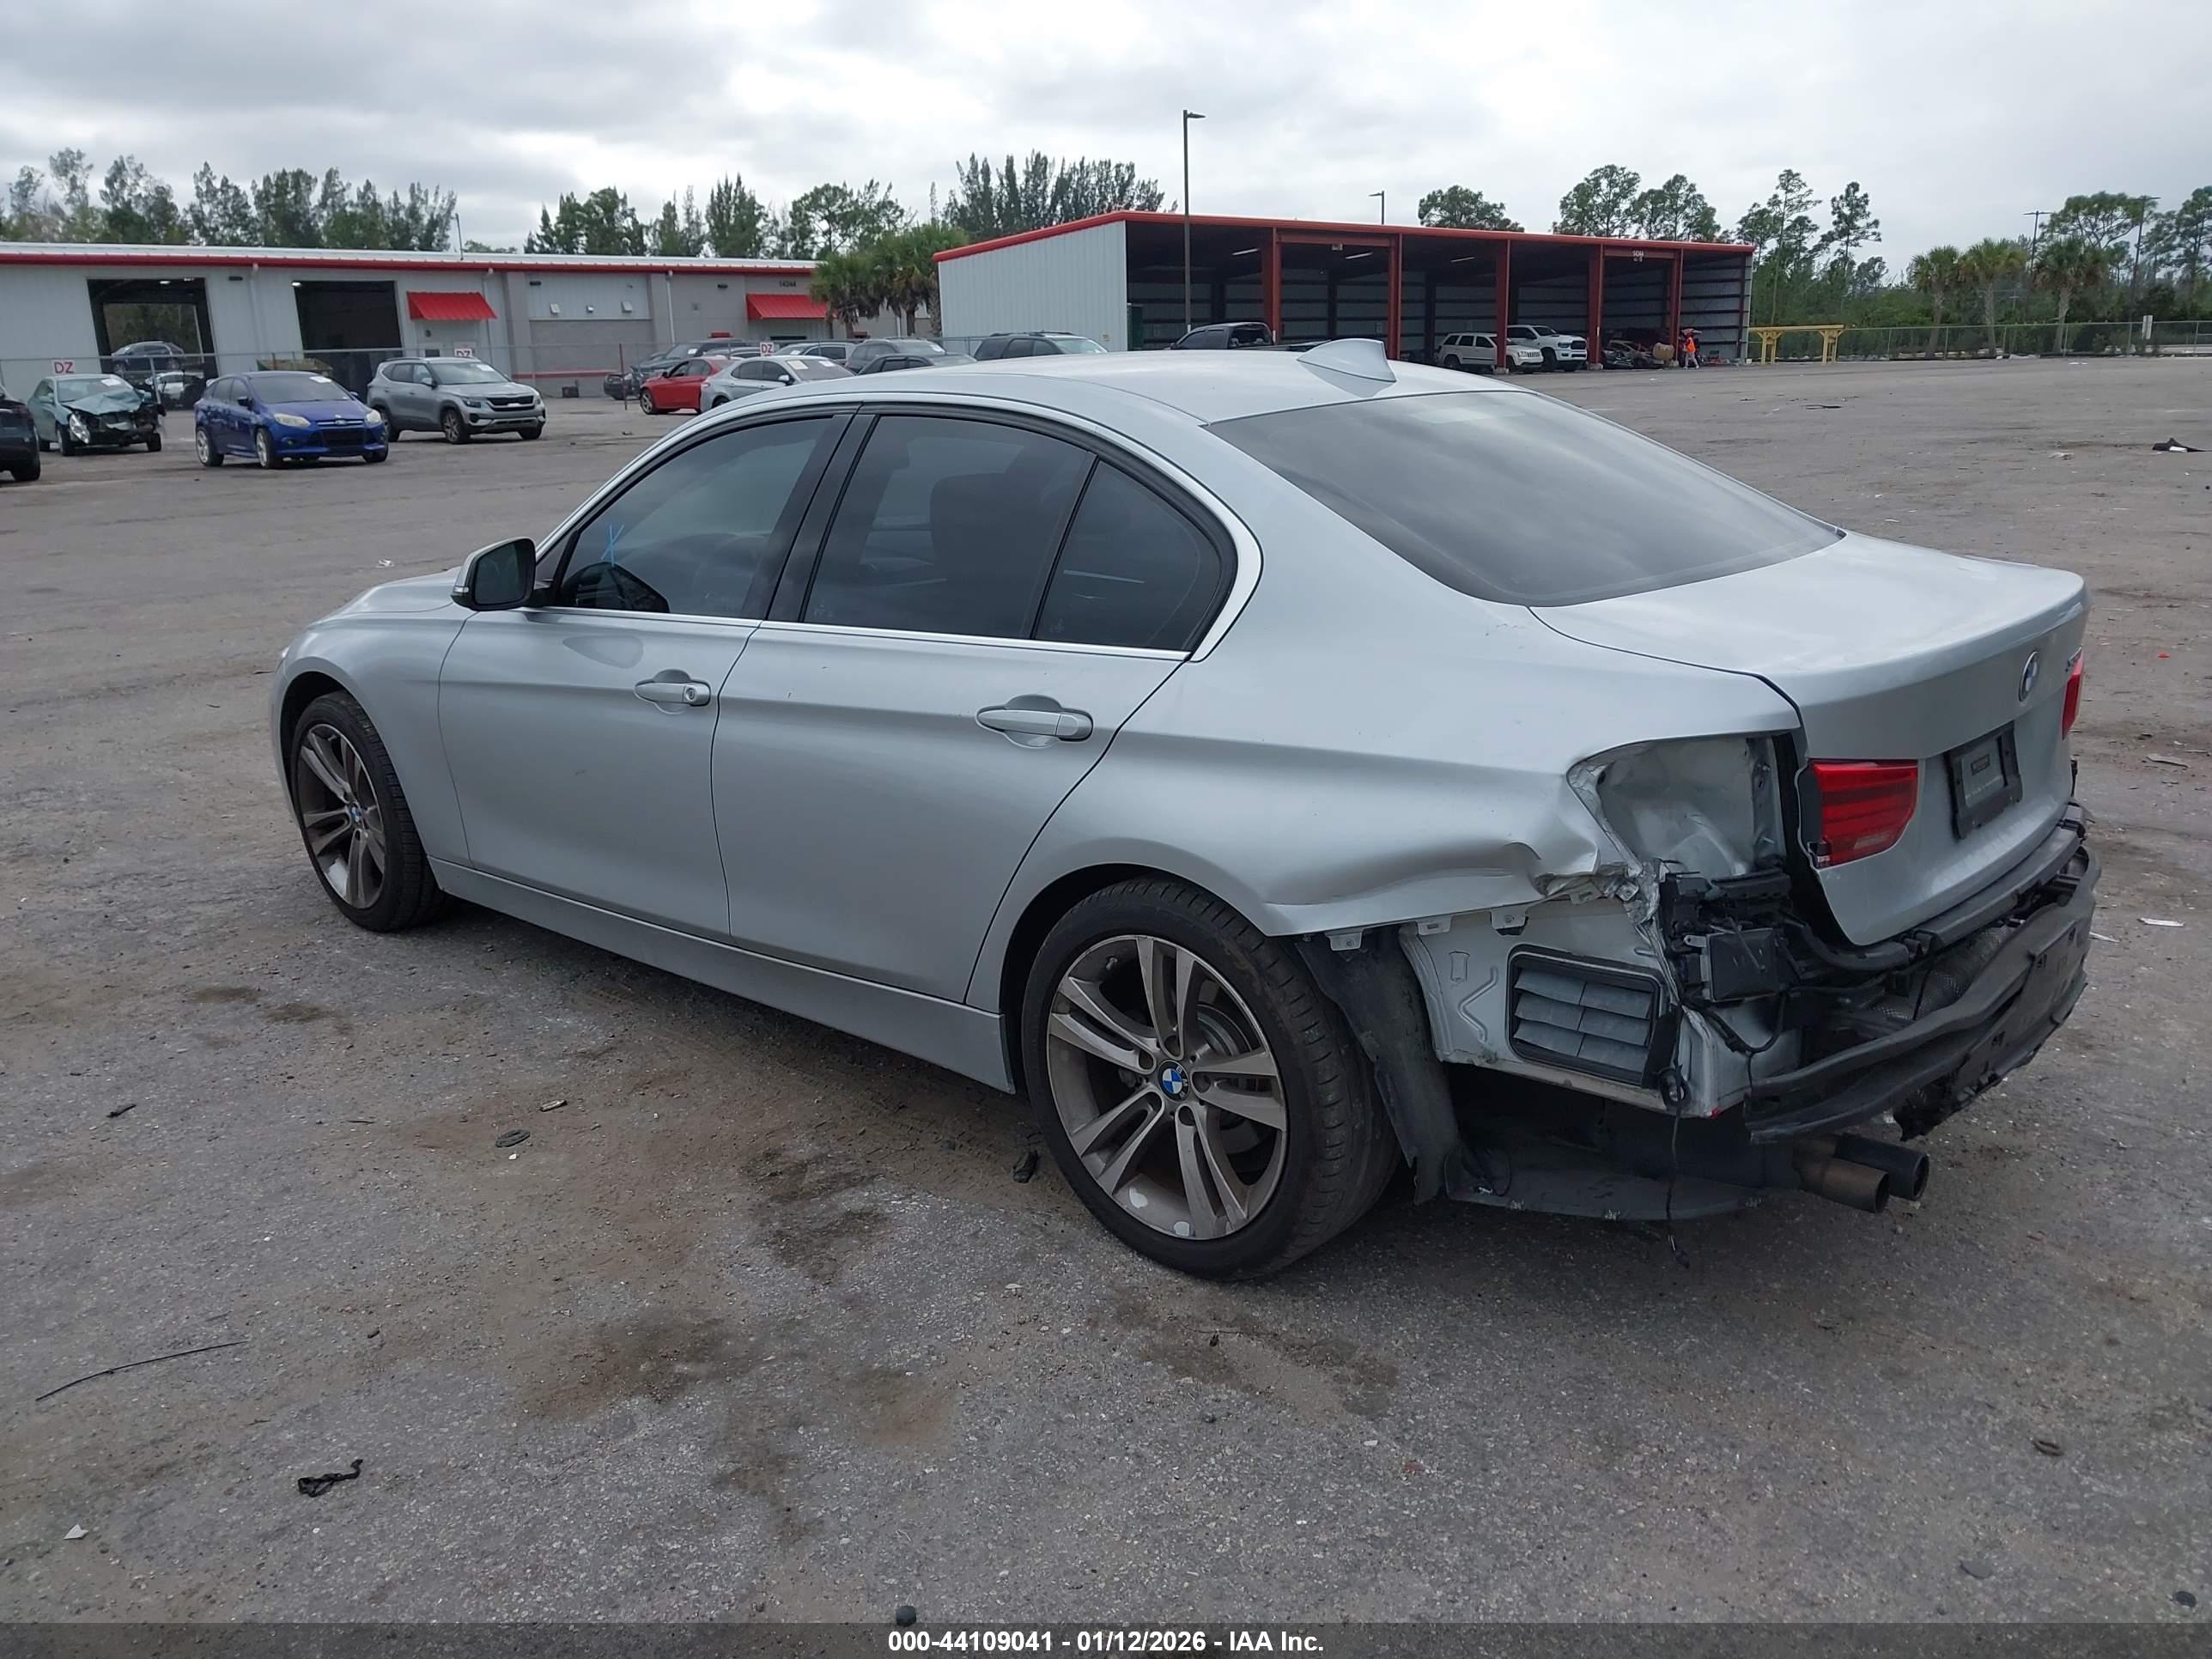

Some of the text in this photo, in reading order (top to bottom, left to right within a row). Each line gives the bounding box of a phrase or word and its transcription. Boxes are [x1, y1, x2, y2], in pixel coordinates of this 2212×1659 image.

[762, 343, 775, 353] DZ
[54, 362, 75, 374] DZ
[1176, 1066, 1188, 1099] BMW
